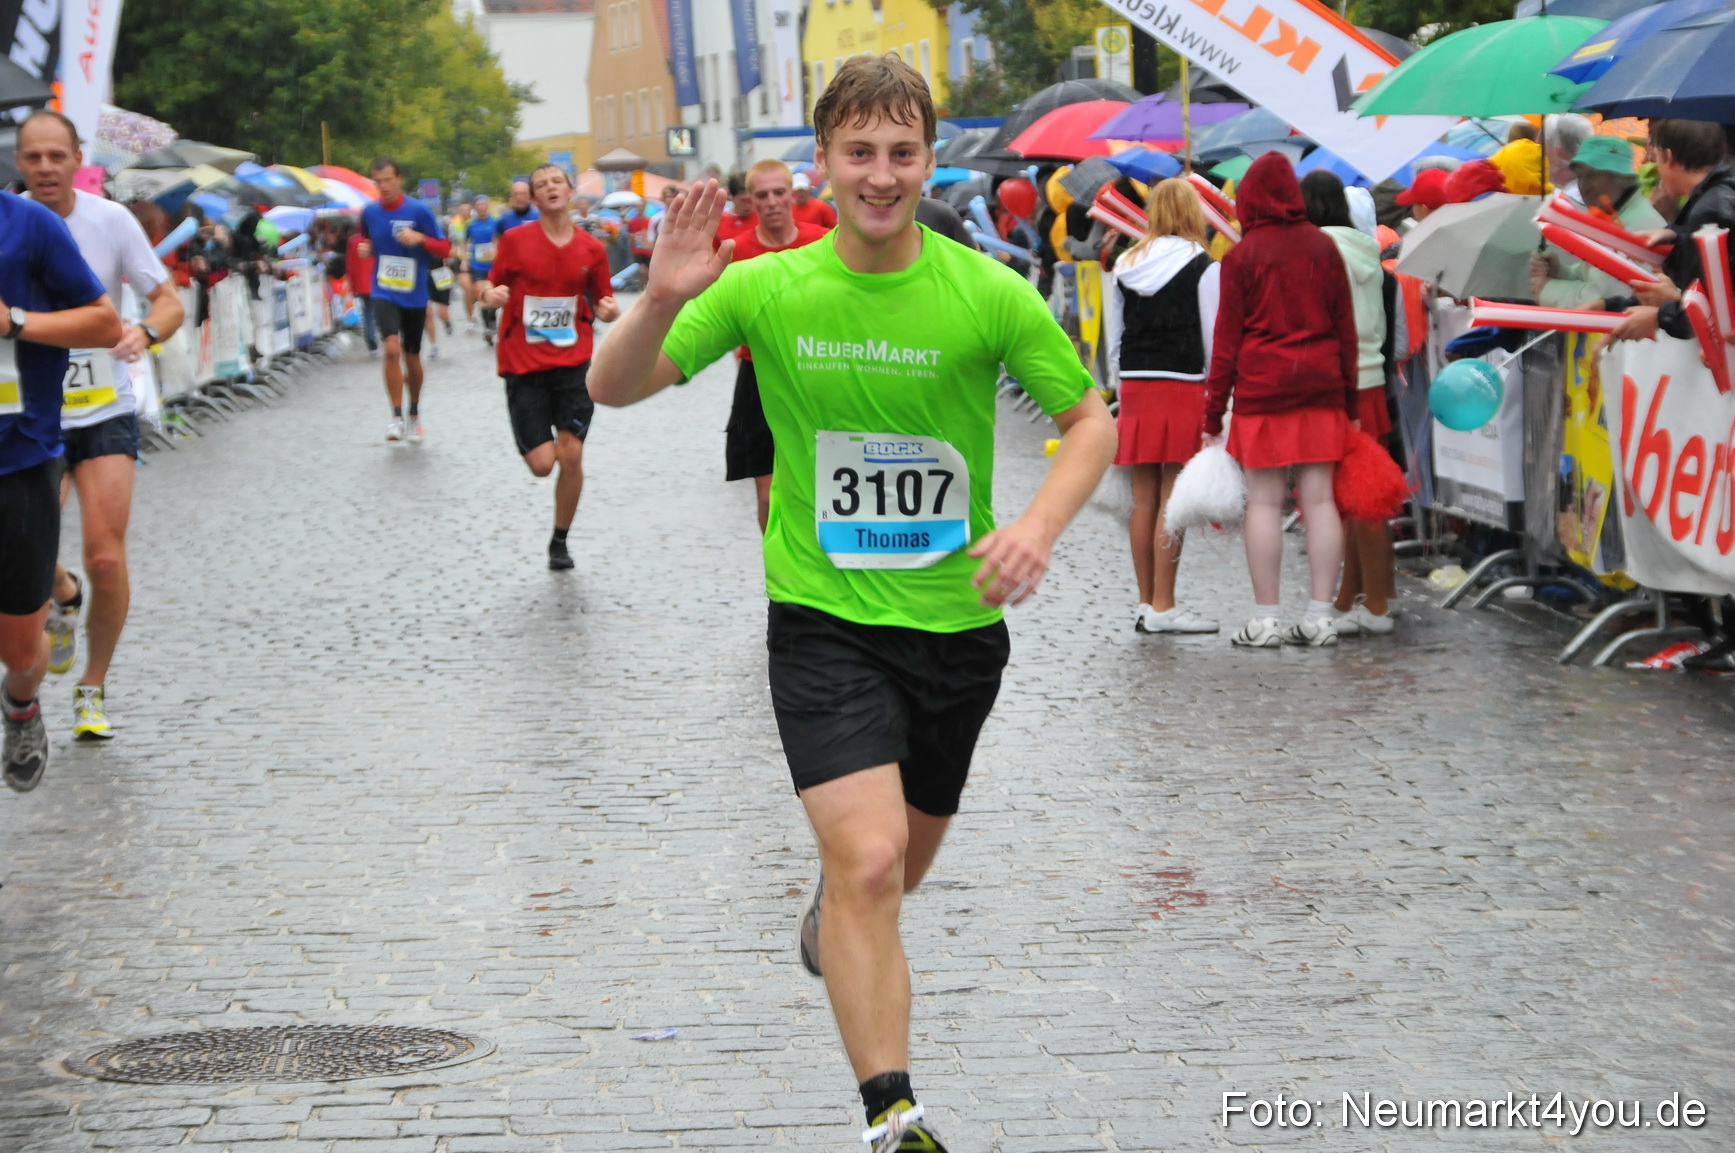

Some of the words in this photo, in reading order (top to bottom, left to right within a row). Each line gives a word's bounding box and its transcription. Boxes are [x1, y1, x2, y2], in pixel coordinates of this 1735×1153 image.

[527, 310, 571, 328] 2230
[863, 441, 924, 456] BOCK
[832, 467, 955, 517] 3107
[855, 528, 931, 549] Thomas
